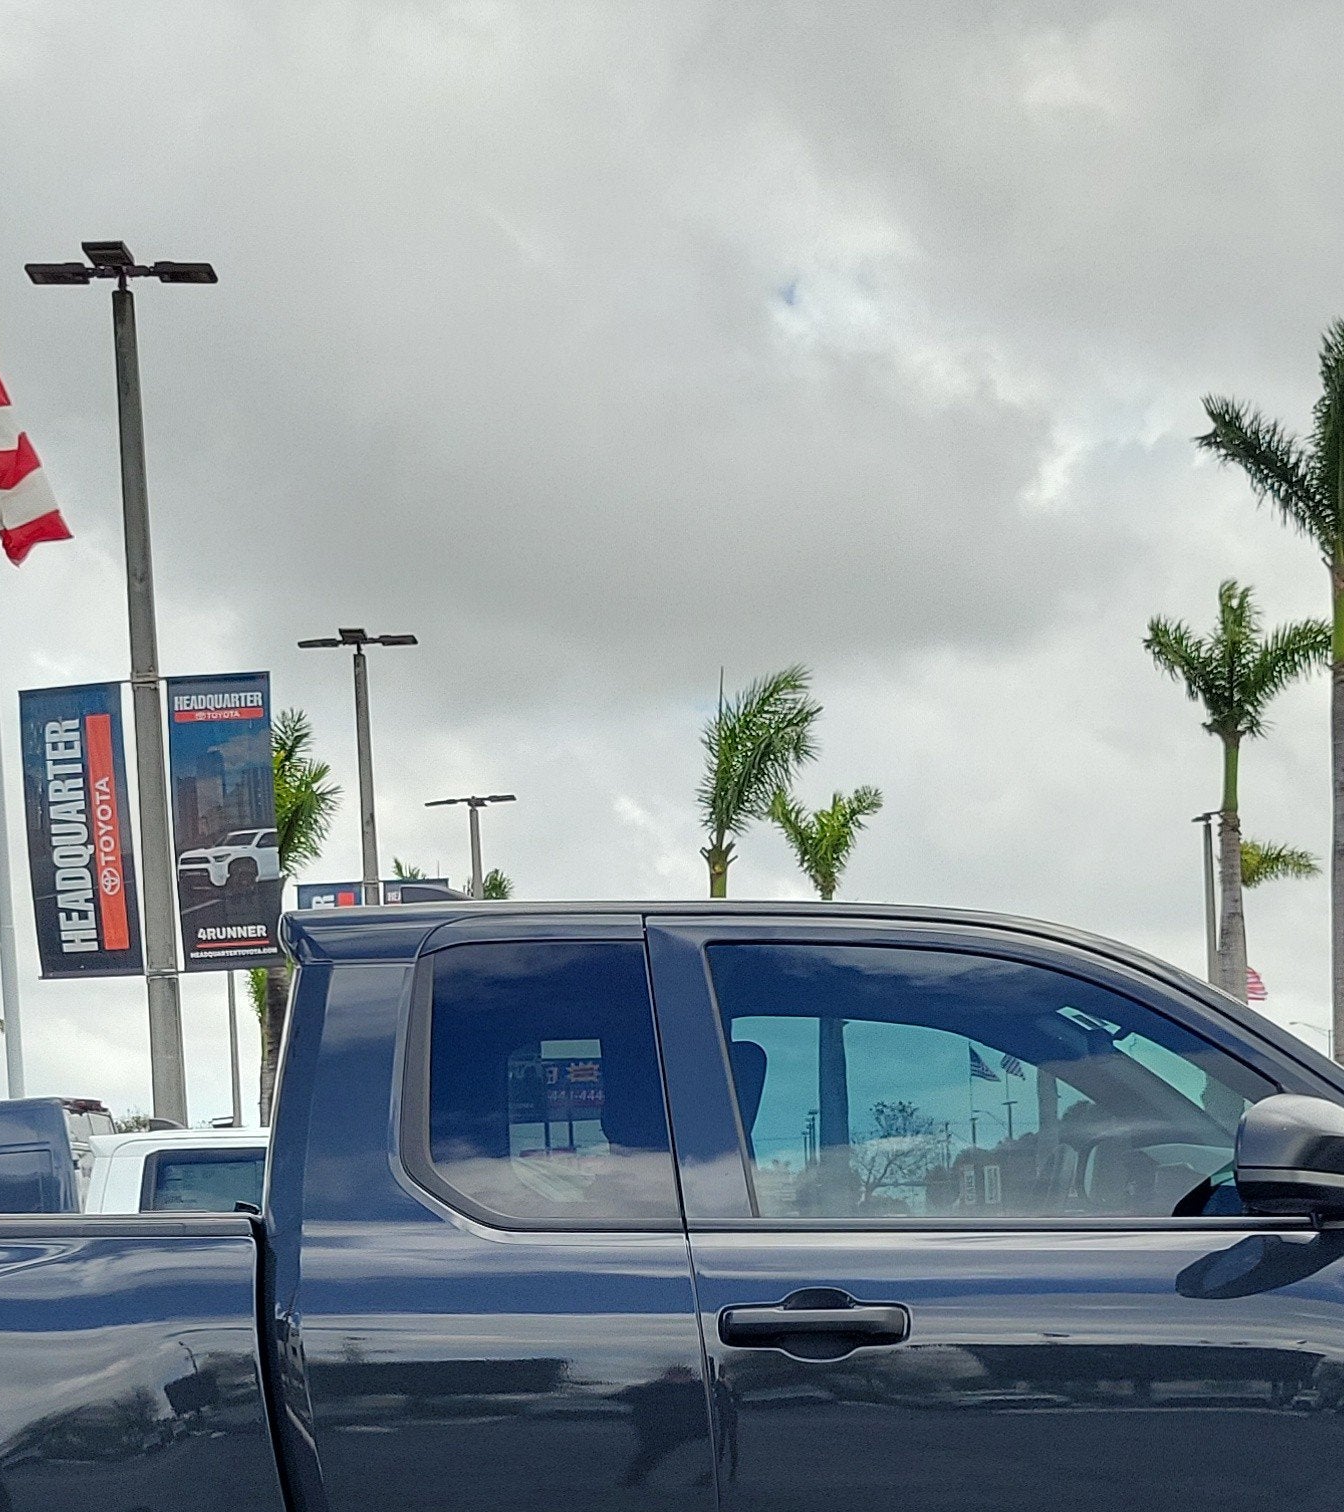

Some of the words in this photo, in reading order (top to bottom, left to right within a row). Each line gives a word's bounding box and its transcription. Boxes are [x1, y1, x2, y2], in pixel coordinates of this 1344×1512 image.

[174, 692, 263, 711] HEADQUARTER
[207, 710, 241, 719] TOYOTA
[95, 776, 116, 866] TOYOTA
[45, 718, 99, 953] HEADQUARTER
[197, 925, 267, 940] 4RUNNER
